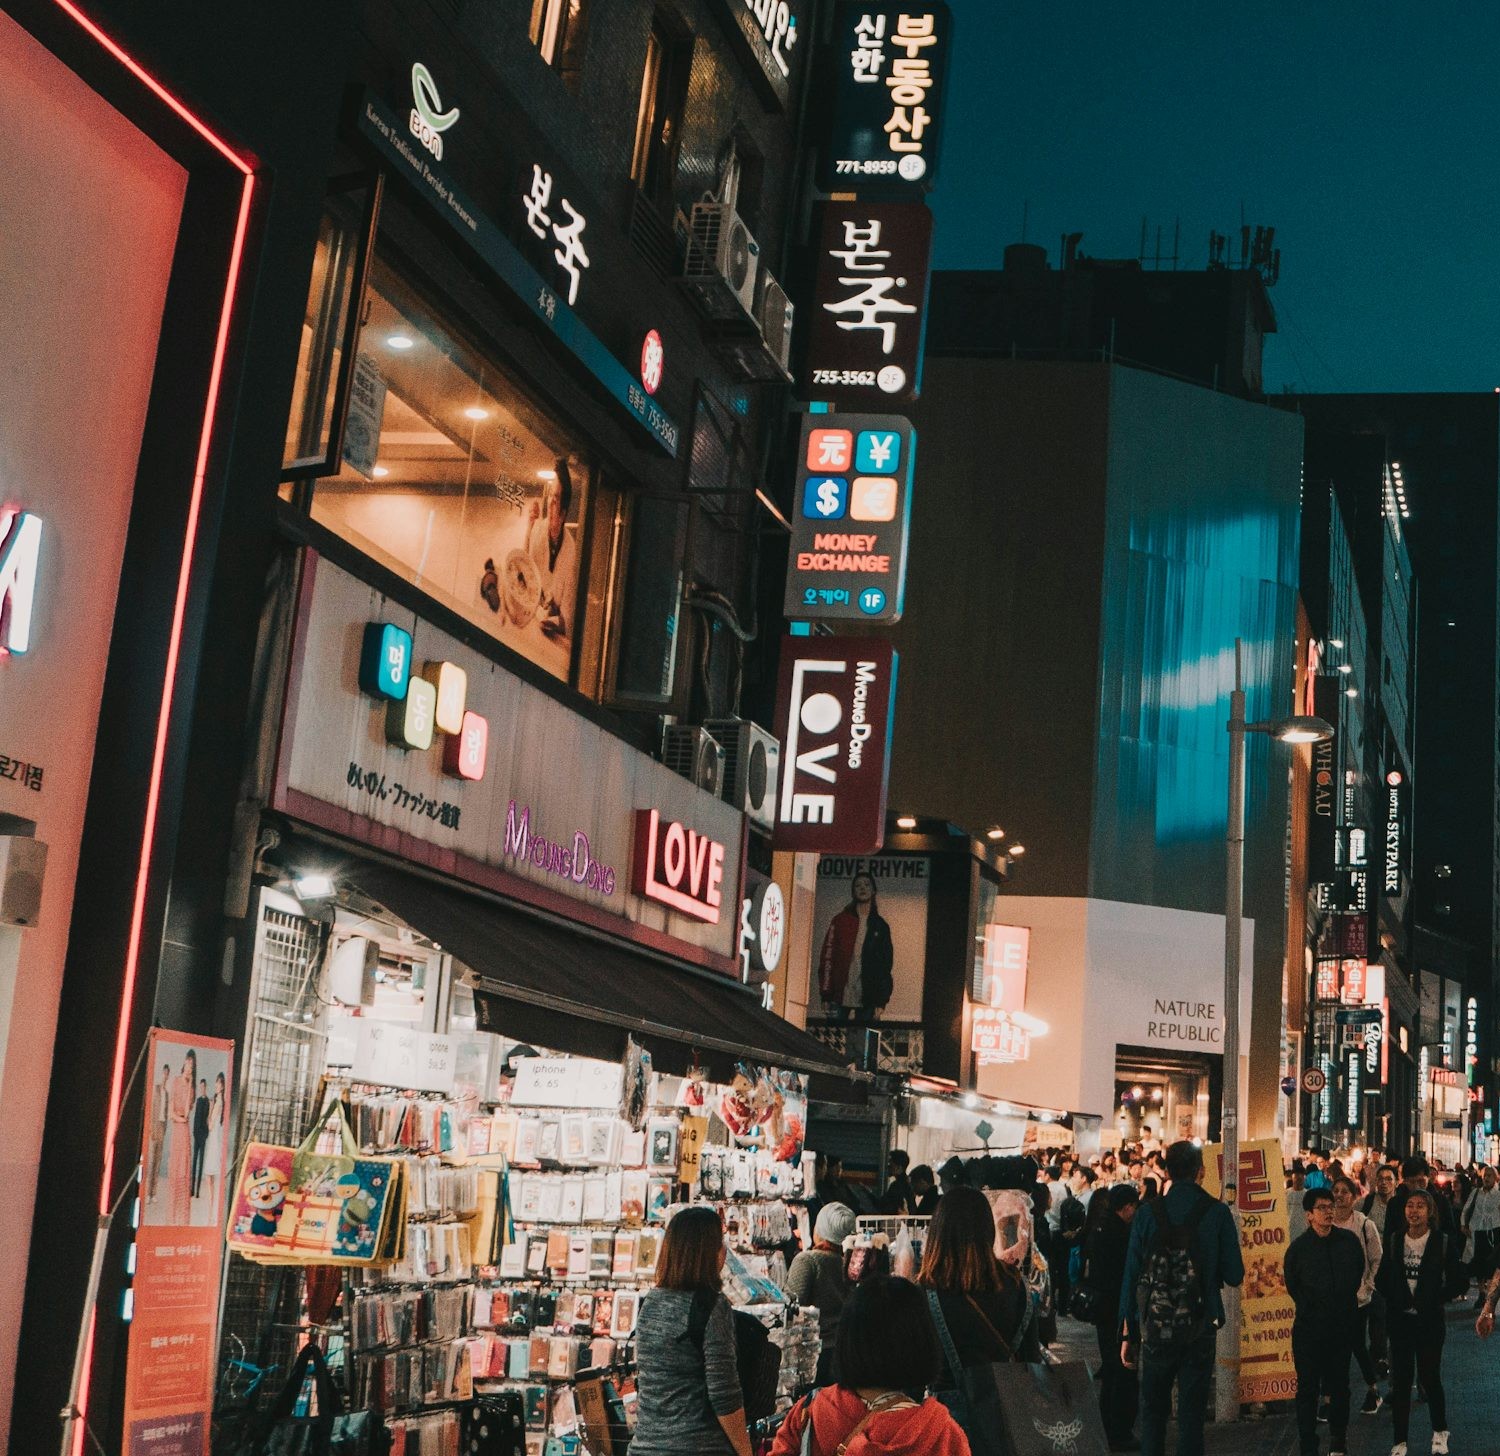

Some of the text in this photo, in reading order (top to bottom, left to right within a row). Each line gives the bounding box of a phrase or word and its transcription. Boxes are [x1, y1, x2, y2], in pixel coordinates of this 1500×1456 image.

[851, 13, 885, 83] 신한
[883, 13, 937, 152] 부동산
[823, 219, 917, 355] 본죽
[812, 369, 876, 387] 755-3562
[818, 435, 847, 465] 元
[814, 533, 878, 552] MONEY
[797, 552, 890, 573] EXCHANGE
[864, 593, 881, 608] 1F
[780, 659, 846, 824] LOVE
[1385, 788, 1399, 892] HOTEL SKYPARK
[646, 809, 726, 925] LOVE
[1154, 999, 1216, 1020] NATURE
[1148, 1022, 1220, 1043] REPUBLIC
[1348, 1053, 1358, 1078] LINE
[1306, 1075, 1322, 1086] 30
